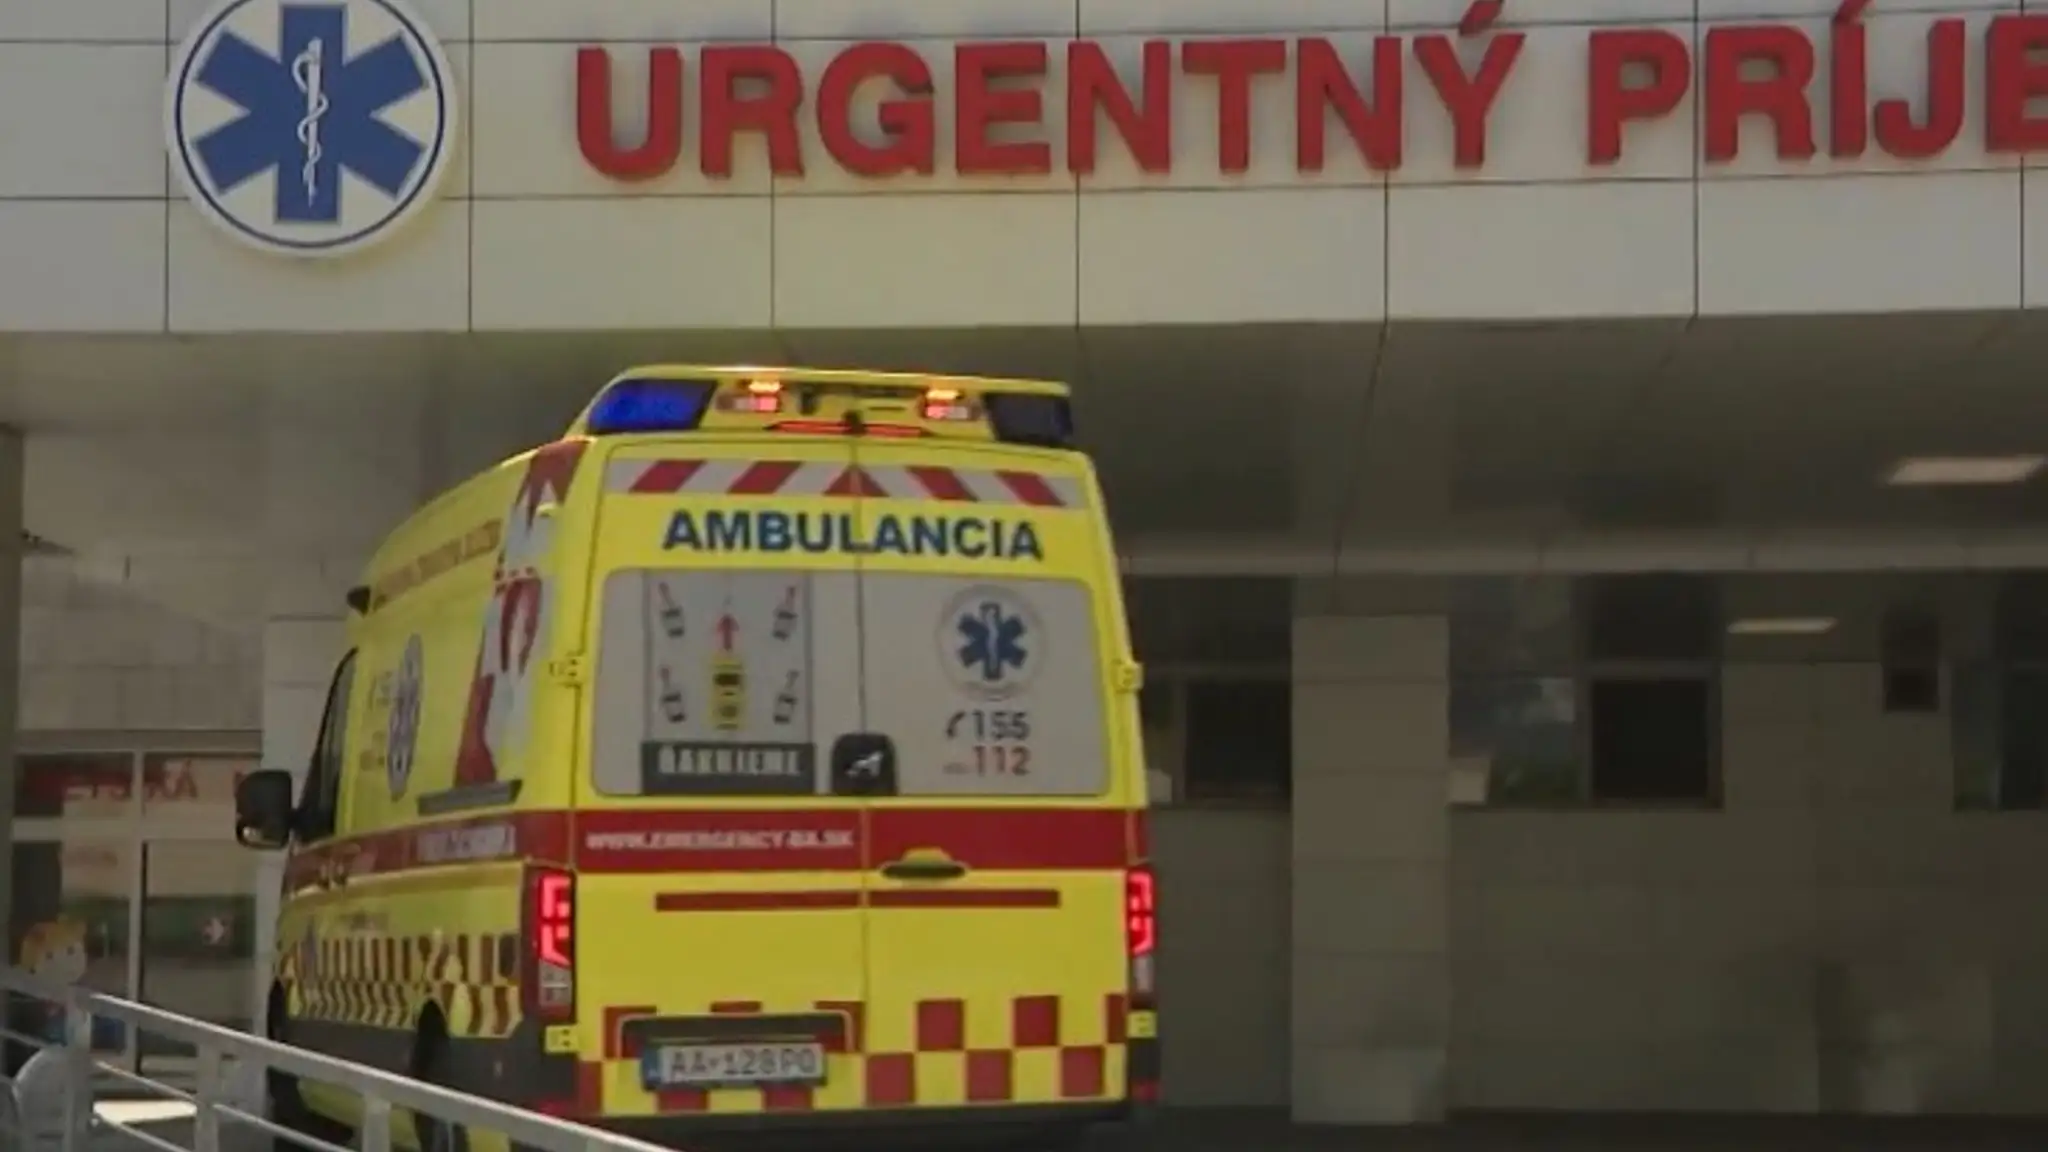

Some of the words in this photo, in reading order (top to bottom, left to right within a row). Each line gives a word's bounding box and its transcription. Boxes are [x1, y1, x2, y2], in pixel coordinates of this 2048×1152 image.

[577, 0, 1527, 179] URGENTNÝ
[1587, 0, 2048, 165] PRÍJE
[662, 508, 1043, 561] AMBULANCIA
[971, 709, 1031, 741] 155
[971, 745, 1032, 776] 112
